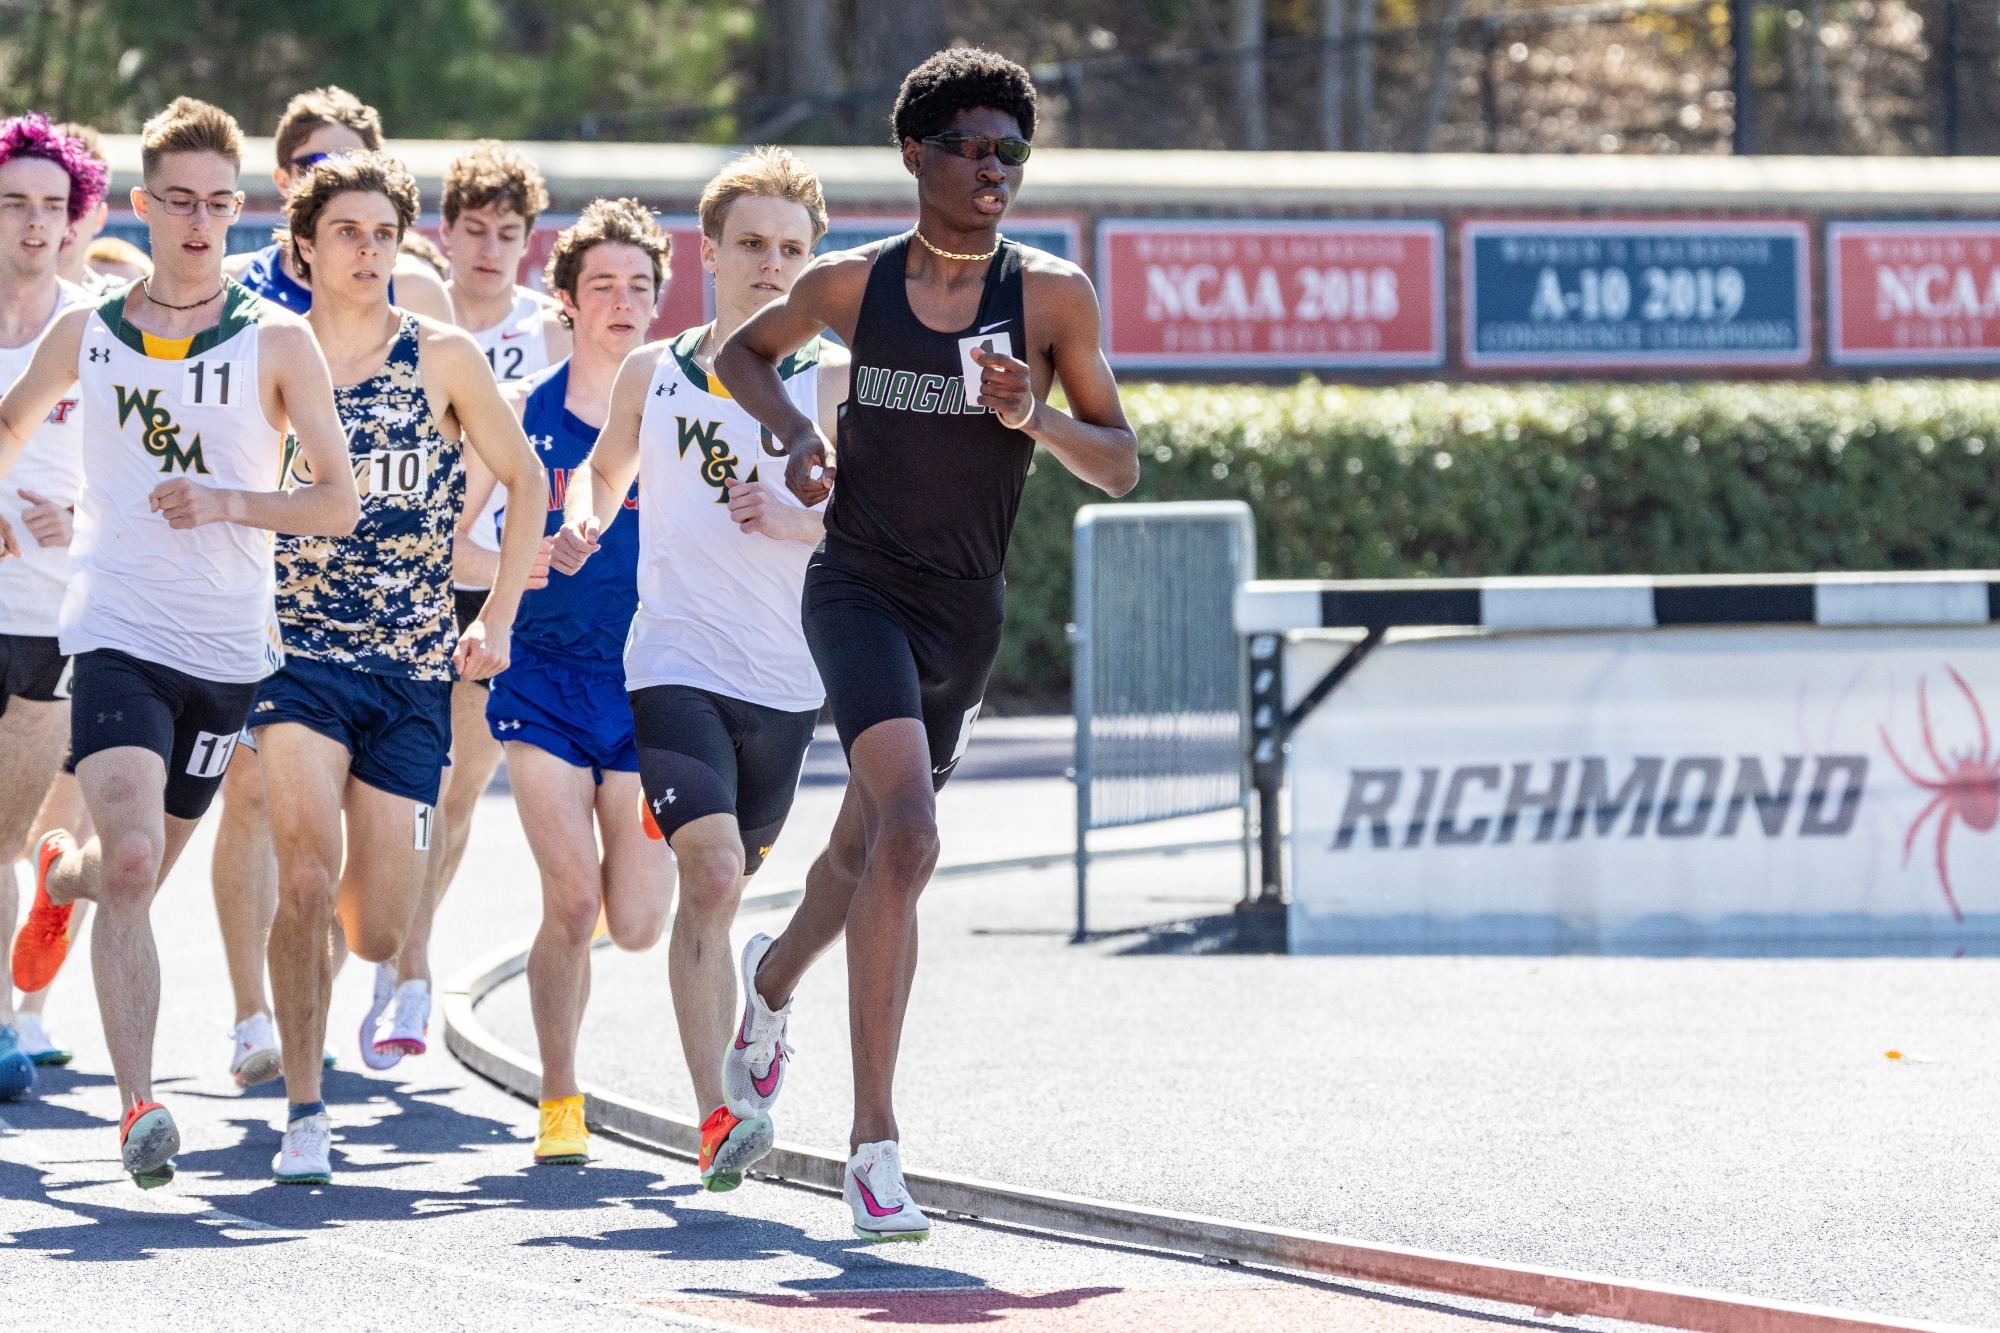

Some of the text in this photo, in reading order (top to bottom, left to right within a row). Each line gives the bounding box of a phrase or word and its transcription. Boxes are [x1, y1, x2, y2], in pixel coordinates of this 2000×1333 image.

[1146, 264, 1399, 321] NCAA 2018
[1531, 266, 1746, 323] A-10 2019
[189, 361, 230, 405] 11
[484, 348, 523, 379] 12
[857, 366, 997, 414] WAGN
[112, 384, 213, 475] W&M
[375, 453, 419, 491] 10
[199, 736, 234, 775] 11
[1328, 755, 1869, 852] RICHMOND
